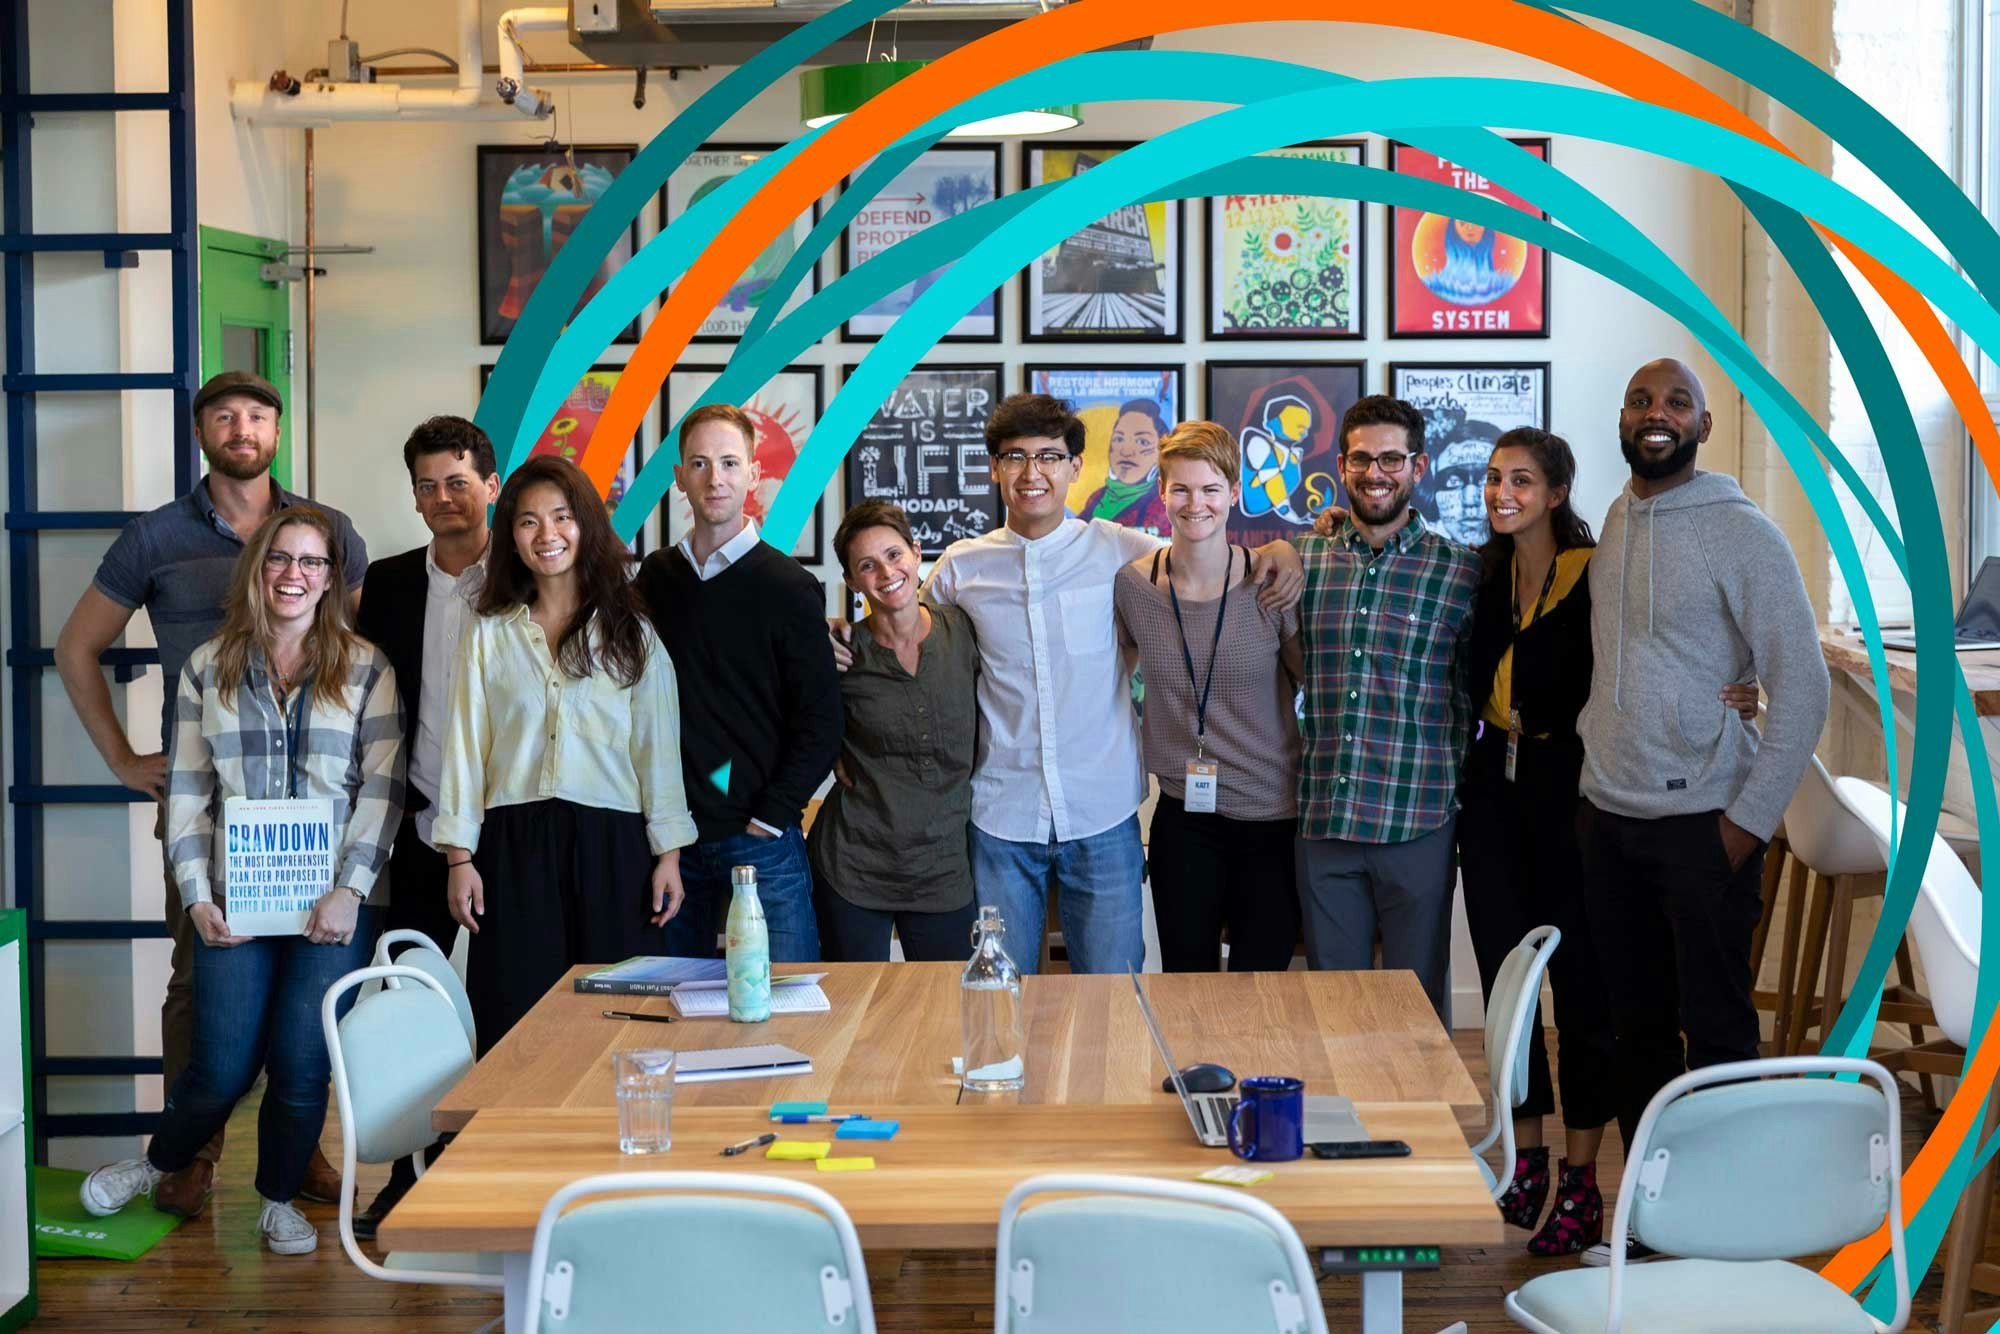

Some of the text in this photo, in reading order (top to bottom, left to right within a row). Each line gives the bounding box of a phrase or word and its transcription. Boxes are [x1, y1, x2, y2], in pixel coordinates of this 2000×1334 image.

[685, 154, 729, 167] GETHER
[1451, 170, 1490, 190] THE
[857, 209, 932, 226] DEFEND
[1432, 310, 1510, 330] SYSTEM
[880, 388, 989, 419] WATER
[911, 420, 936, 442] IS
[858, 444, 990, 497] LIFE
[884, 498, 970, 513] NODAPL
[229, 822, 329, 853] DRAWDOWN
[230, 854, 329, 868] THE MOST COMPREHENSIVE
[230, 868, 330, 883] PLAN EVER PROPOSED TO
[230, 884, 260, 898] REVERSE
[263, 884, 290, 898] GLOBAL
[230, 899, 258, 913] EDITED
[262, 899, 273, 912] BY
[275, 899, 293, 912] PAUL
[35, 1224, 108, 1240] STO
